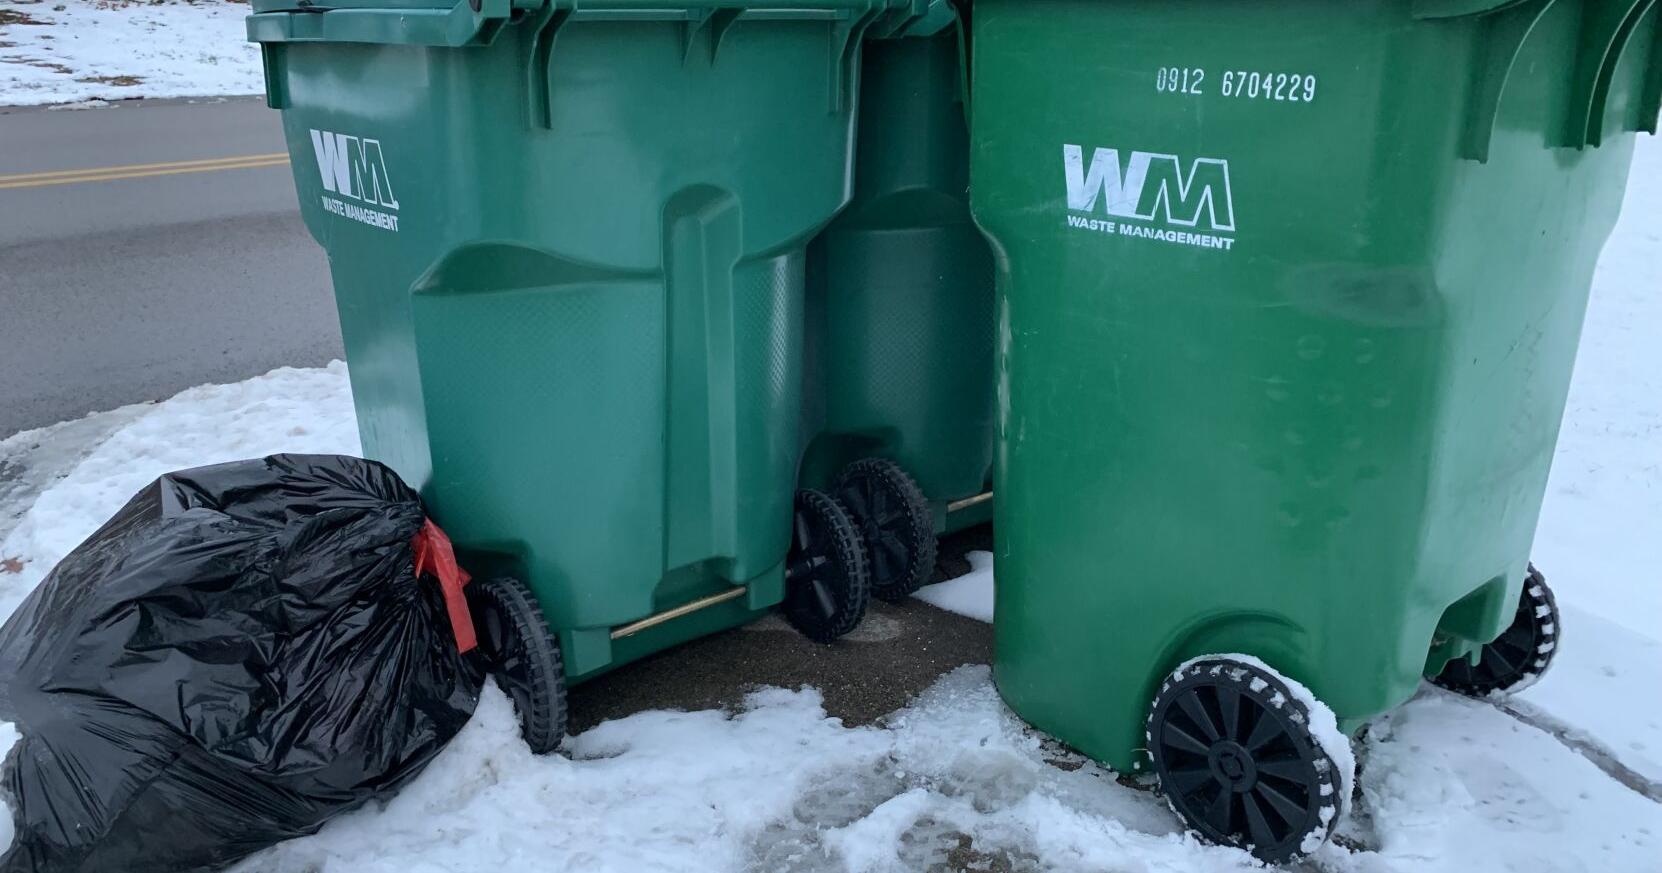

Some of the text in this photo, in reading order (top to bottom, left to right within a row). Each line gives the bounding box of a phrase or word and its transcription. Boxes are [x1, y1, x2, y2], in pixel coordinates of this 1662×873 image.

[1156, 66, 1316, 102] 0912 6704229
[309, 128, 398, 210] WM
[1063, 143, 1236, 232] WM
[321, 195, 398, 232] WASTE MANAGEMENT
[1067, 214, 1235, 250] WASTE MANAGEMENT
